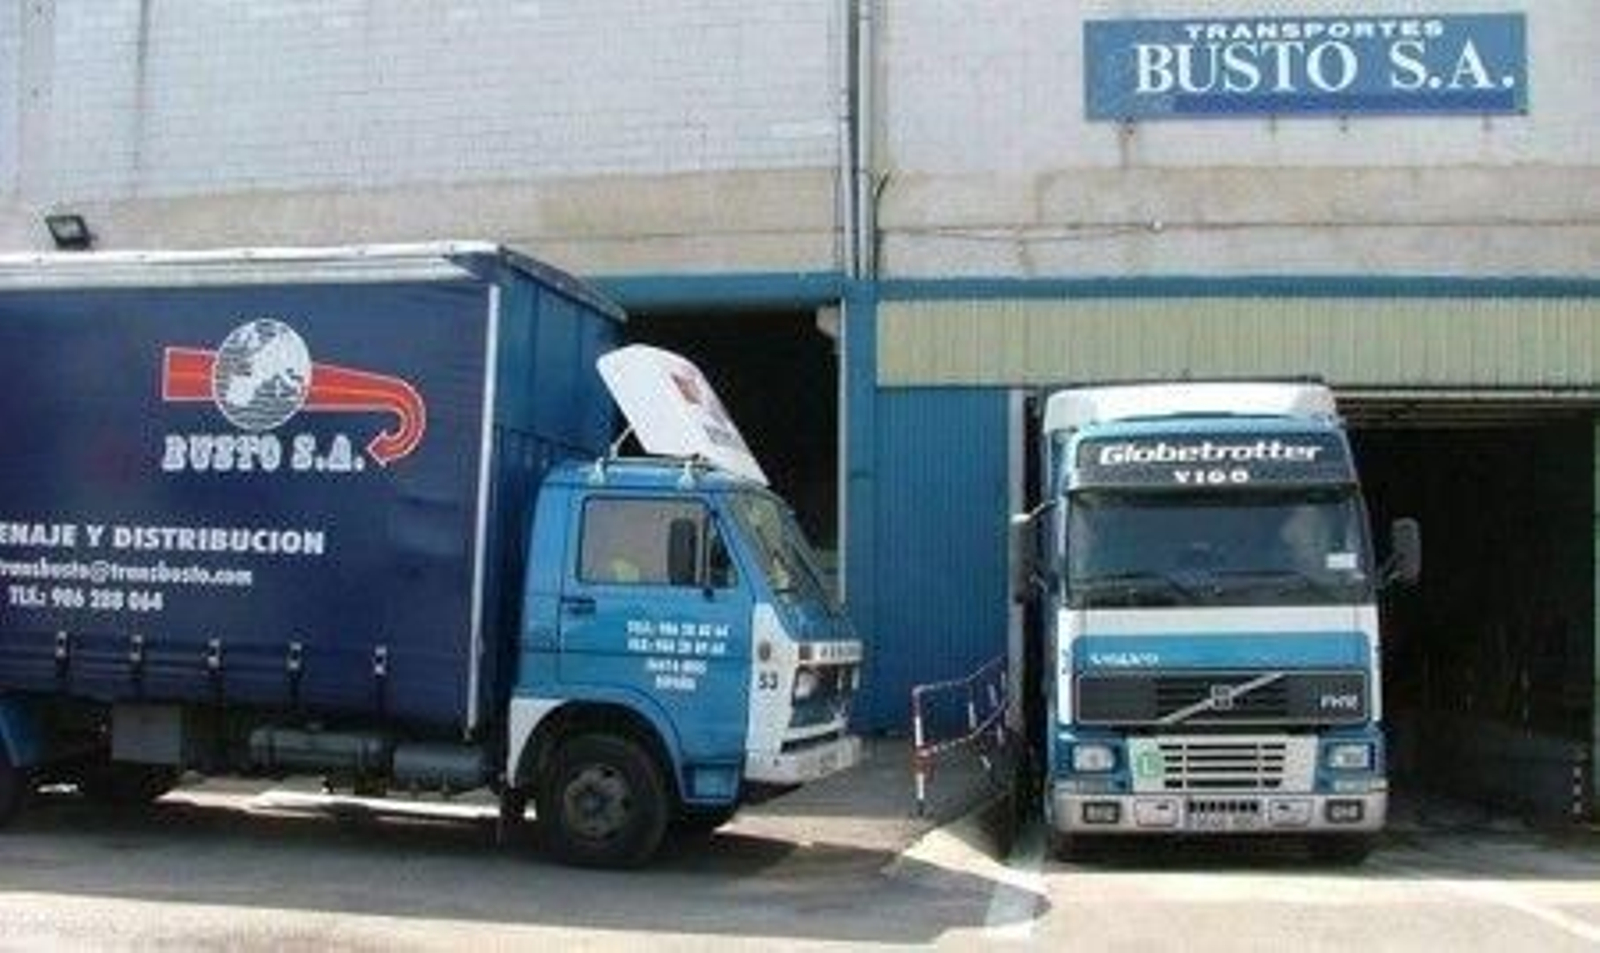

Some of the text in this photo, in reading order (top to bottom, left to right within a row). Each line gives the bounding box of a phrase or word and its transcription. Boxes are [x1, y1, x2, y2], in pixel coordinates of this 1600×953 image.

[1184, 20, 1446, 41] TRANSPORTES
[1134, 38, 1516, 94] BUSTO S.A.
[162, 434, 366, 472] BUSTO S.A.
[1099, 441, 1323, 466] Globetrotter
[1173, 469, 1249, 484] VIGO
[86, 523, 105, 548] Y
[114, 526, 325, 556] DISTRIBUCION
[759, 672, 778, 690] 53
